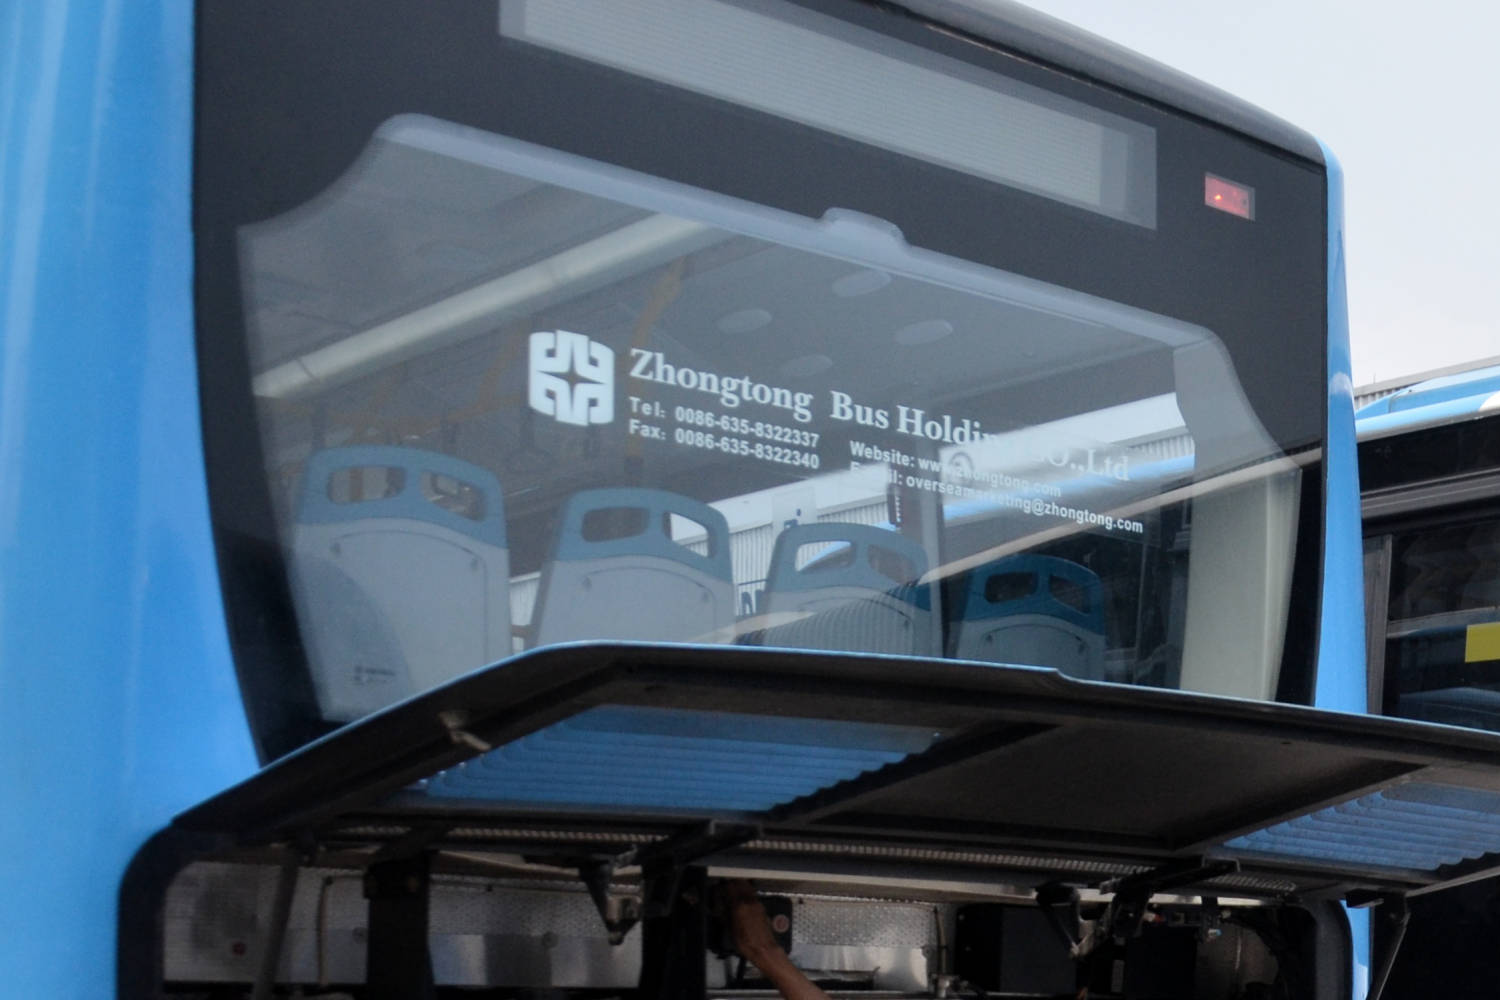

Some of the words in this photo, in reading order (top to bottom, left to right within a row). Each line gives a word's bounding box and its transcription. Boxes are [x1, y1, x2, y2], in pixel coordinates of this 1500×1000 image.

[629, 348, 814, 423] Zhongtong
[829, 390, 890, 429] Bus
[896, 405, 1008, 446] Holdi
[629, 396, 666, 418] Tel:
[674, 405, 820, 448] 0086-635-8322337
[629, 418, 667, 440] Fax:
[674, 427, 820, 470] 0086-635-8322340
[849, 439, 915, 468] Website:
